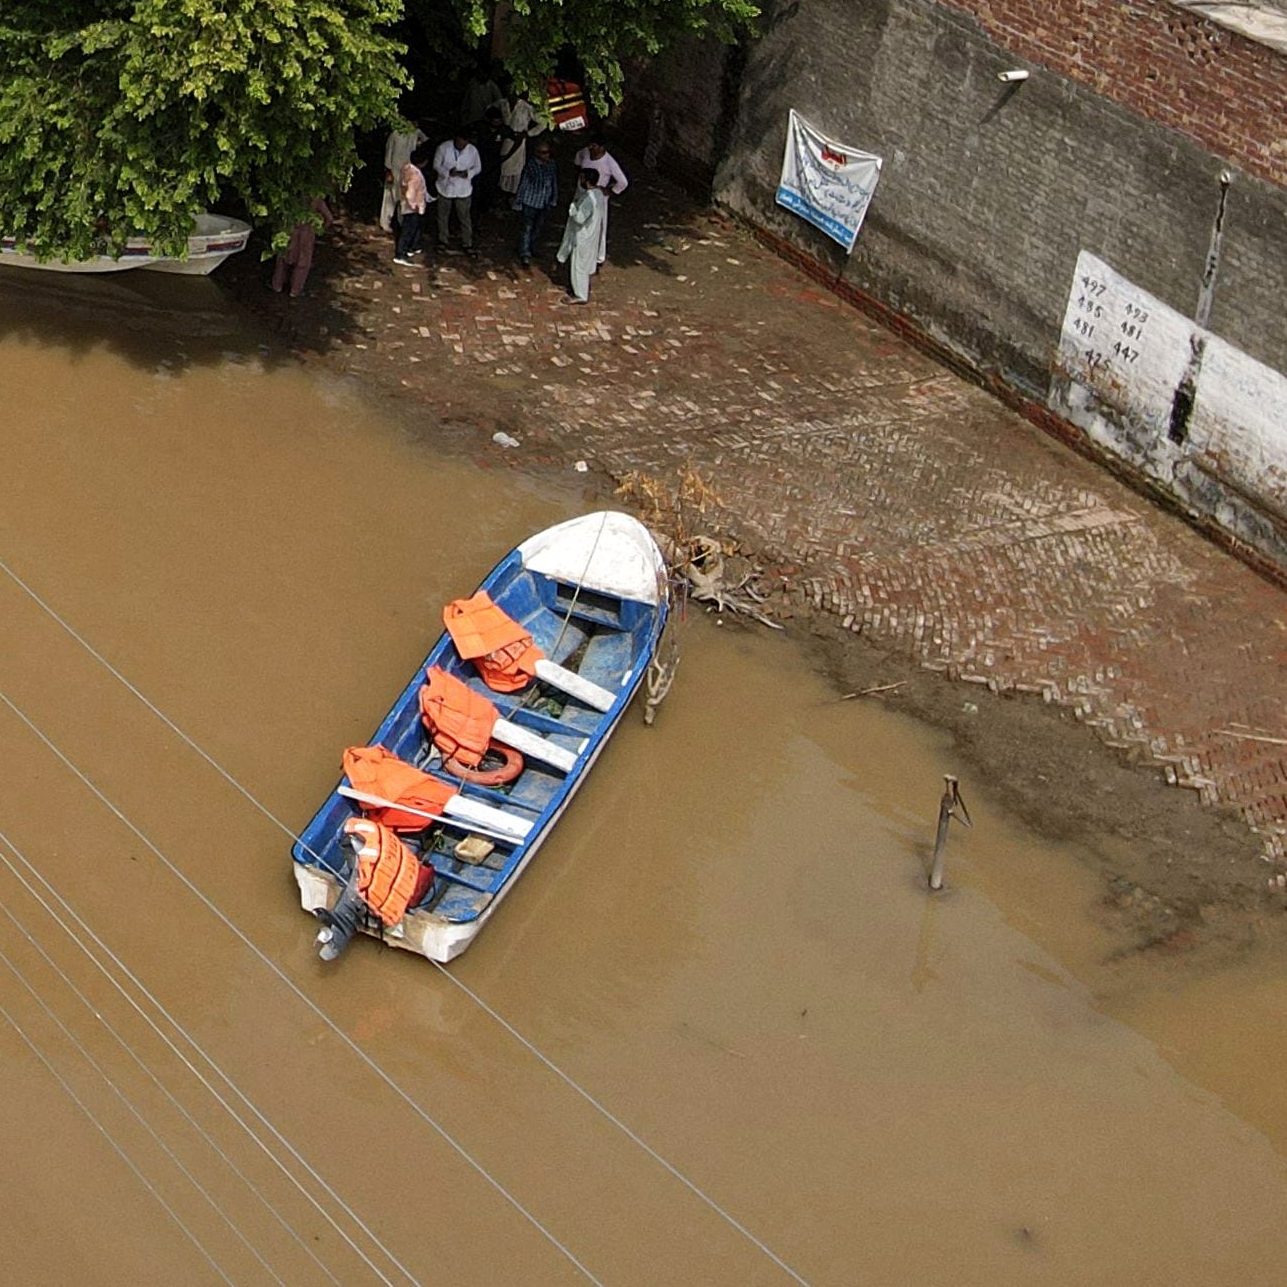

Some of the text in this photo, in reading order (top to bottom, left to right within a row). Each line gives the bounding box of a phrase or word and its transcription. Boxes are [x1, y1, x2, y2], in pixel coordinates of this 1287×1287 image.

[1082, 276, 1150, 324] 497 493
[1073, 317, 1139, 364] 481 447
[1120, 320, 1143, 341] 481
